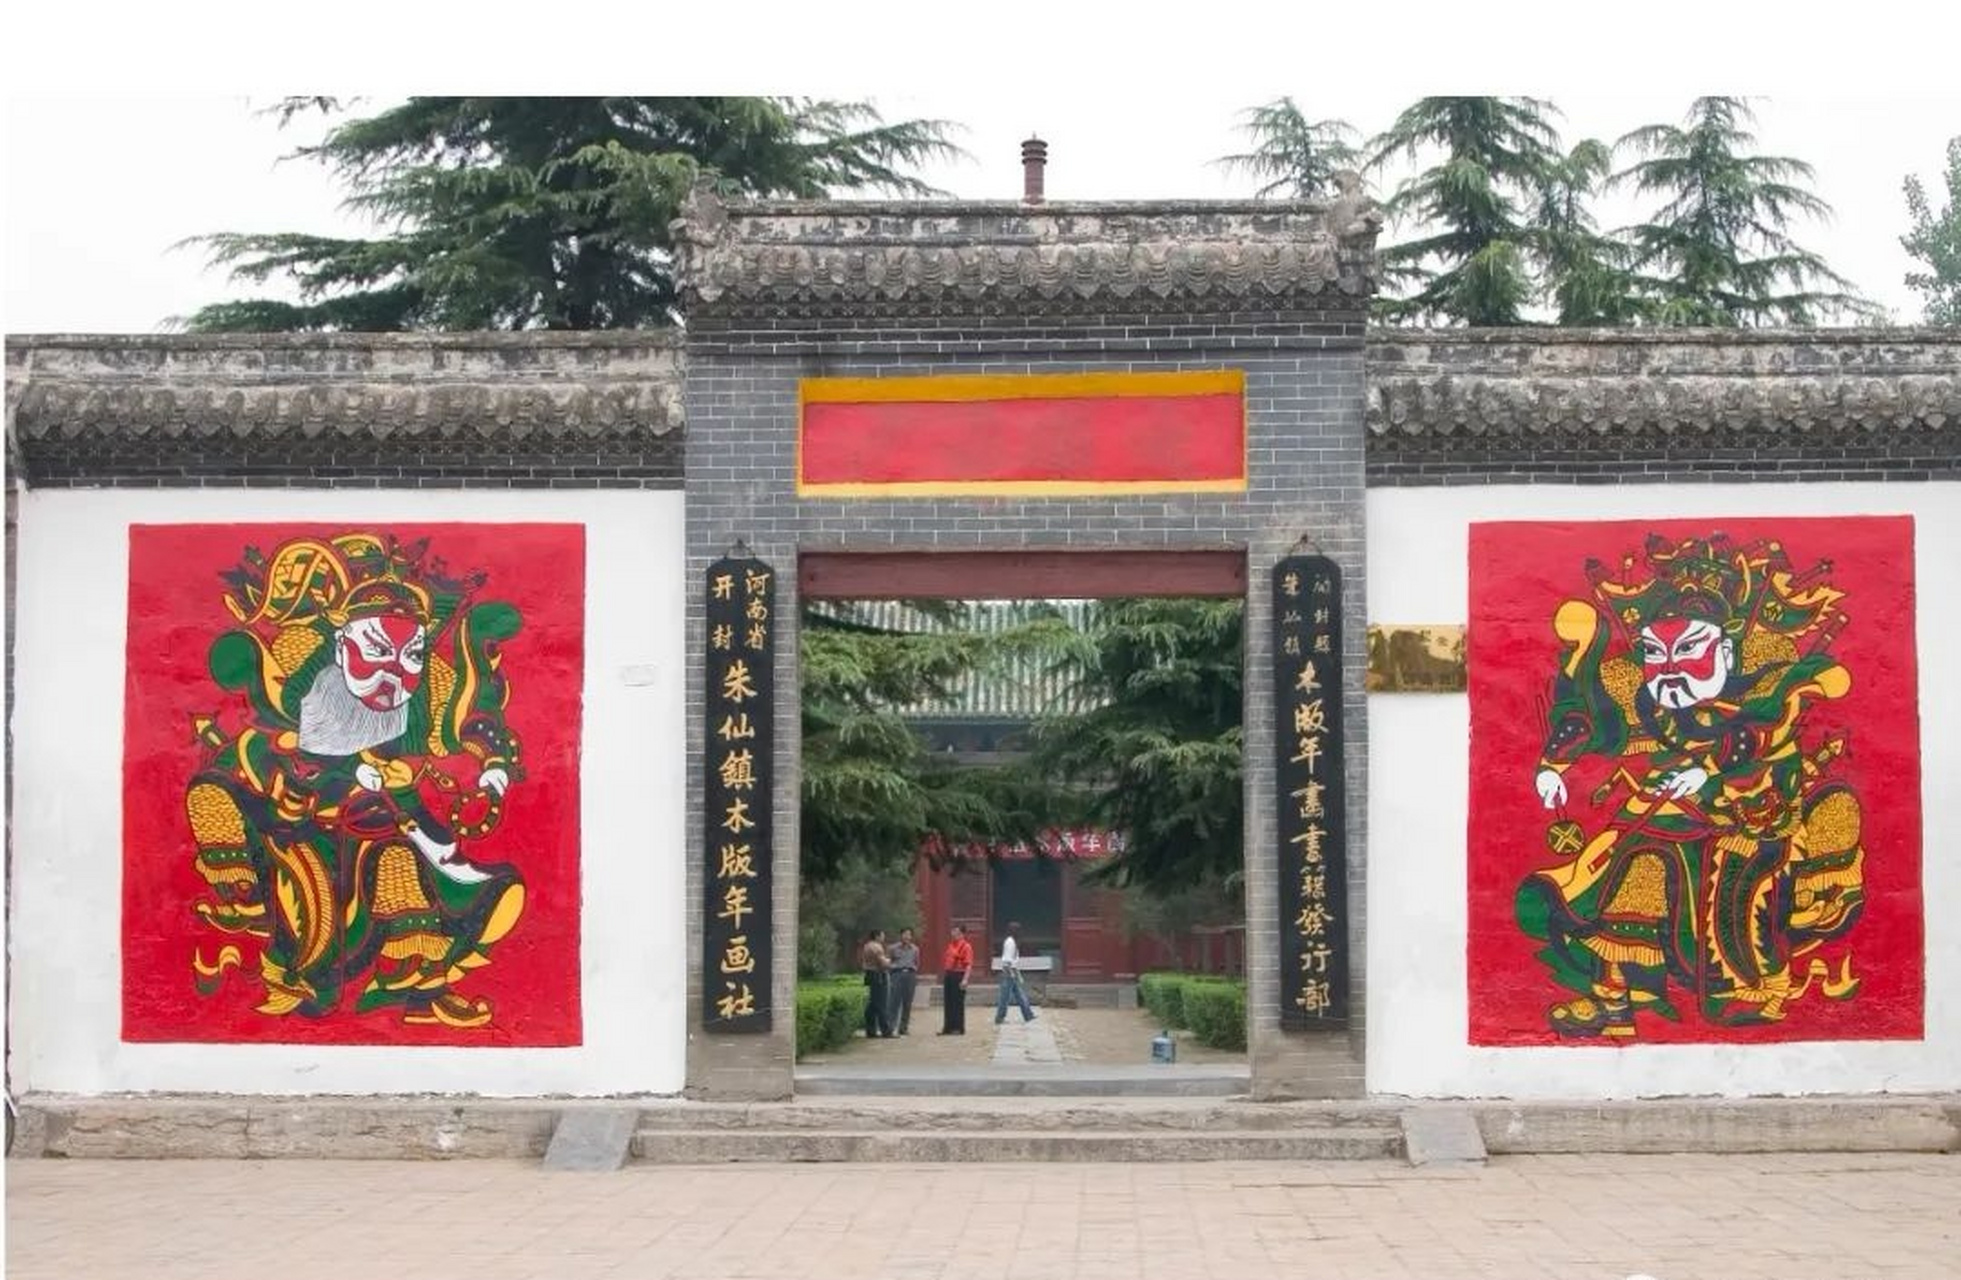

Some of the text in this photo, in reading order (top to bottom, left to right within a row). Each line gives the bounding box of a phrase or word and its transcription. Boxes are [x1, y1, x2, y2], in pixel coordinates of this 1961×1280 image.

[712, 574, 734, 650] 开封
[744, 569, 770, 650] 河南省
